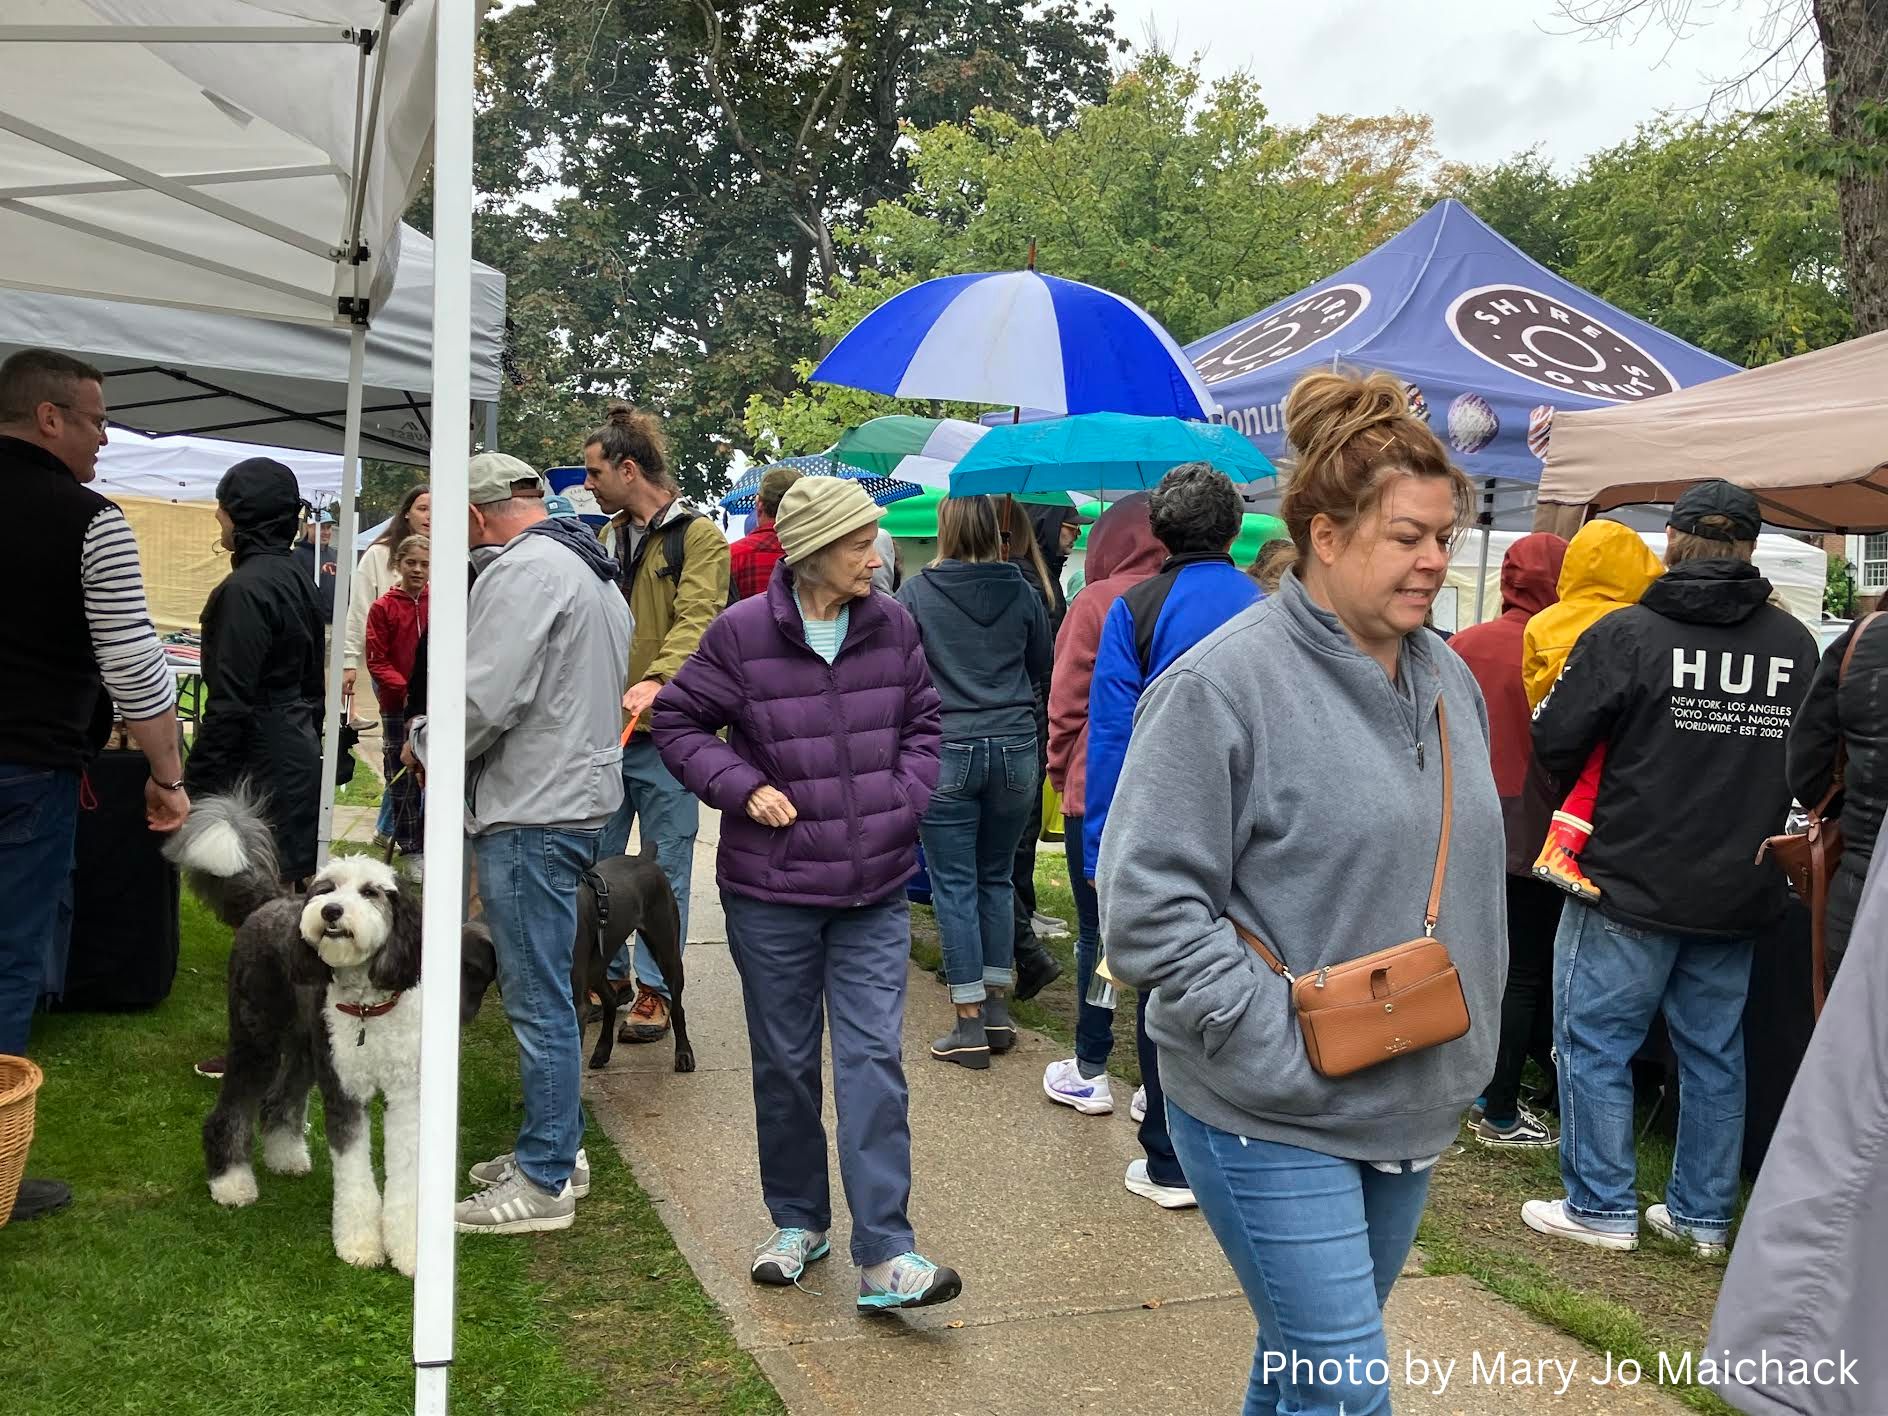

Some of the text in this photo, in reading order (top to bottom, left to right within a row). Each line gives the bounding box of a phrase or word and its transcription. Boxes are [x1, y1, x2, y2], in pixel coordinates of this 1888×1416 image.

[1263, 296, 1347, 331] SHIRE
[1474, 298, 1602, 338] SHIRE
[1196, 346, 1292, 382] DUTS
[1506, 353, 1656, 397] DONUTS
[1672, 648, 1794, 697] HUF
[1670, 707, 1703, 719] TOKYO
[1708, 711, 1740, 723] OSAKA
[1748, 715, 1791, 728] NAGOYA
[1671, 696, 1695, 707] NEW
[1698, 699, 1721, 710] YORK
[1727, 702, 1746, 712] LOS
[1747, 703, 1792, 716] ANGELES
[1674, 720, 1732, 734] WORLDWIDE
[1739, 726, 1758, 737] EST.
[1760, 728, 1783, 739] 2002
